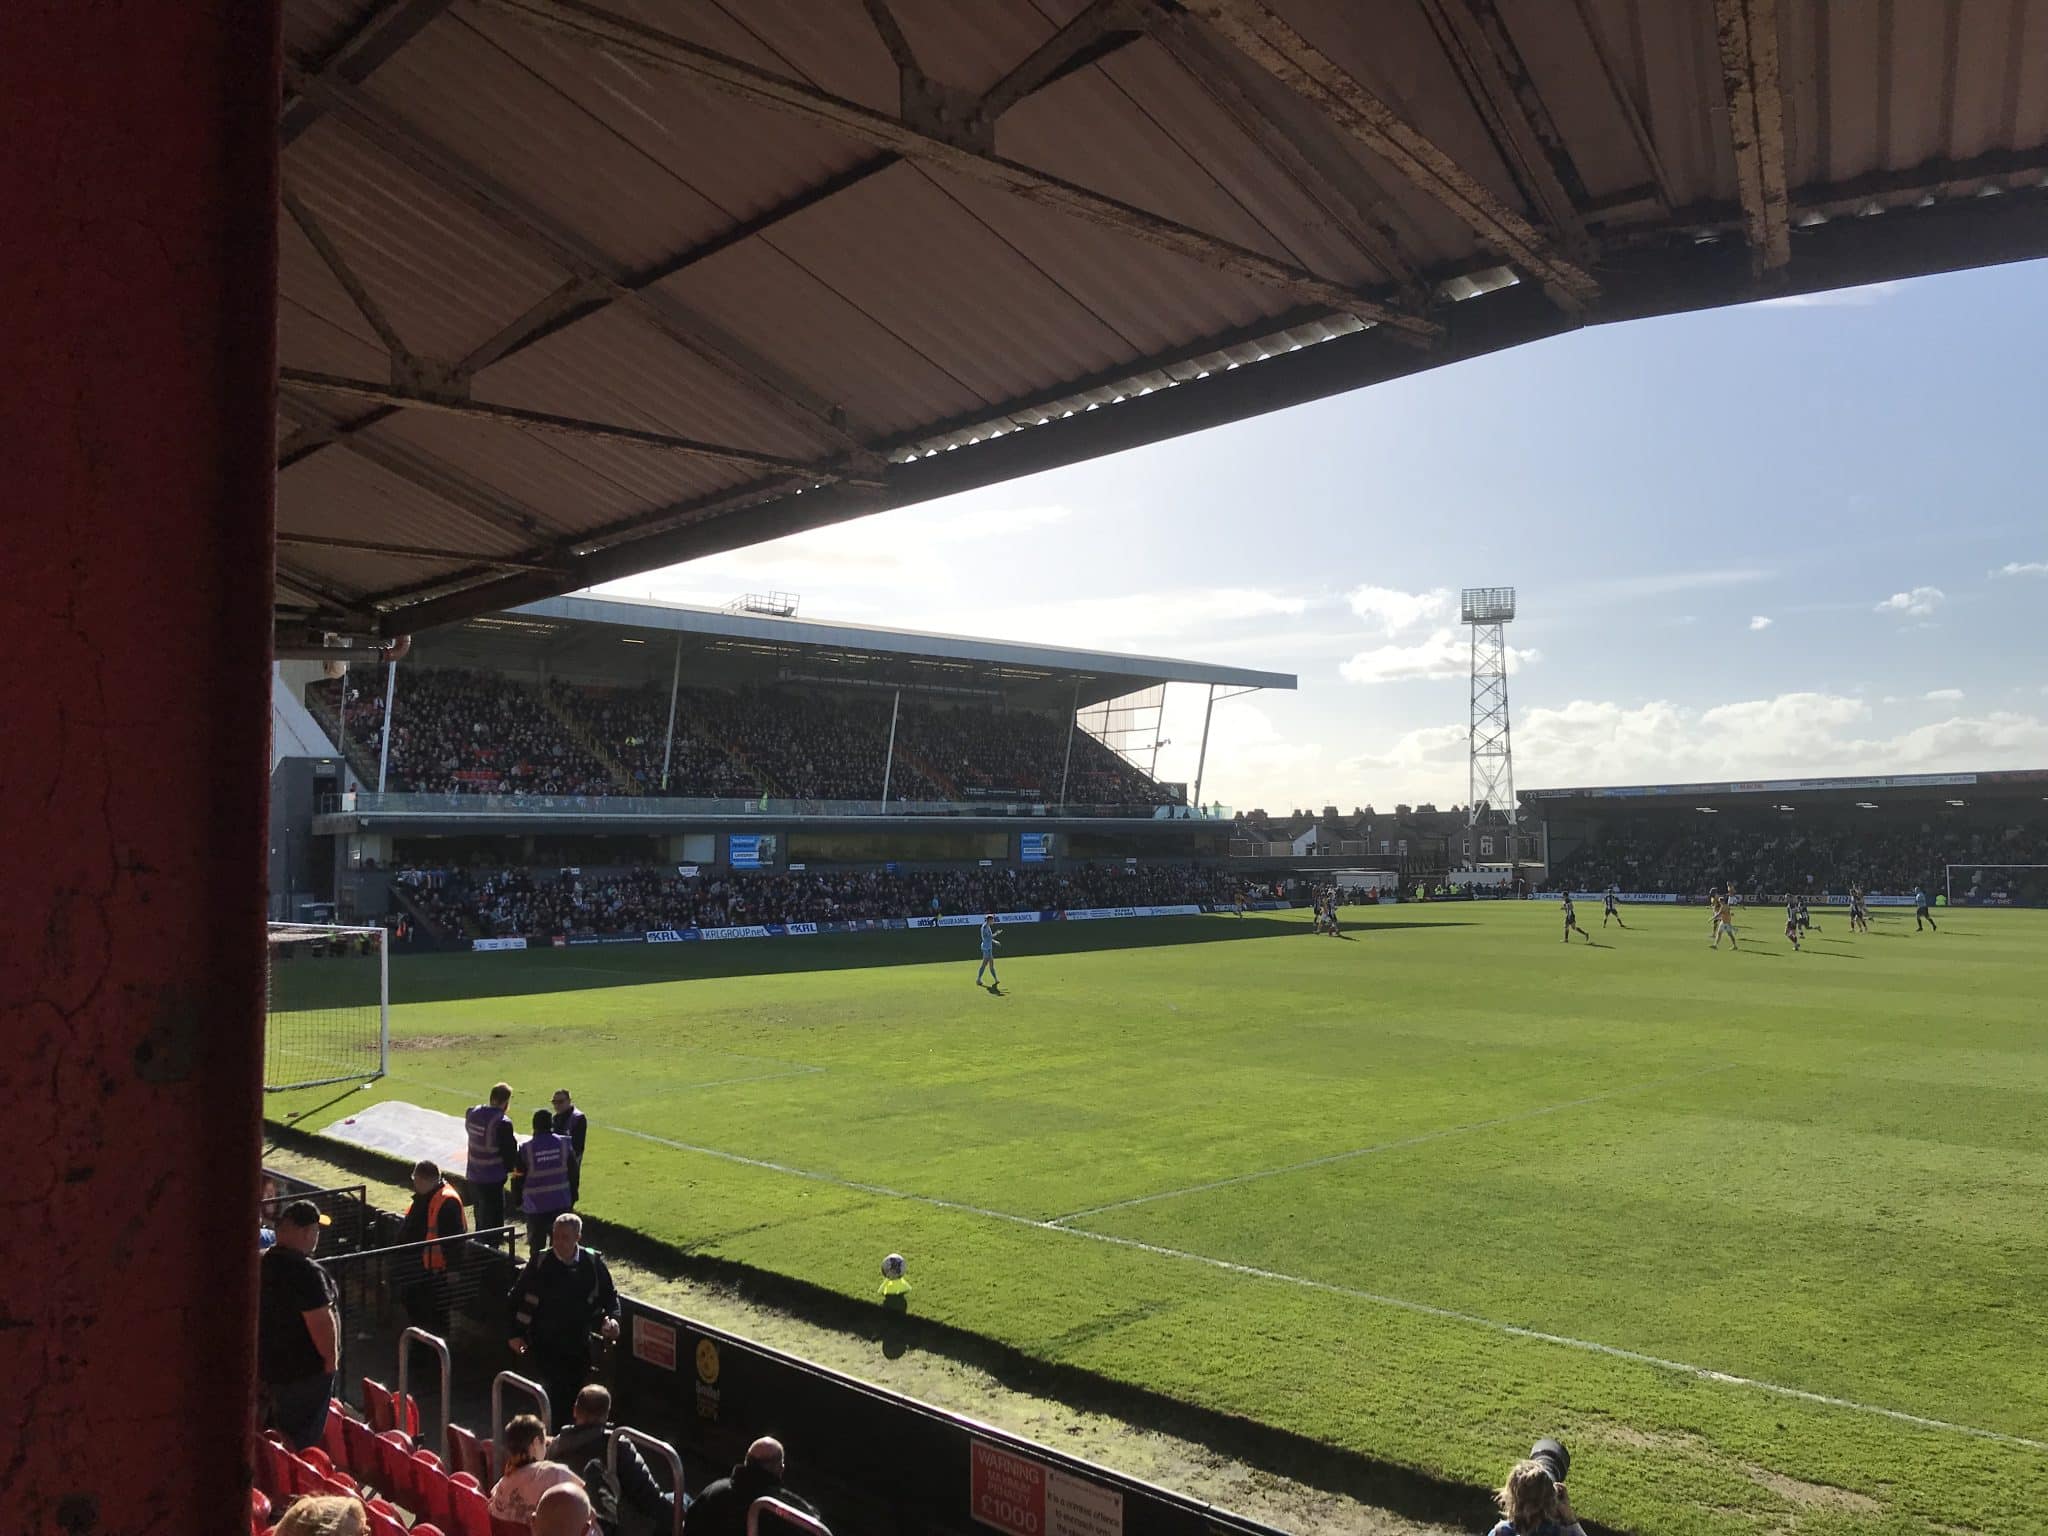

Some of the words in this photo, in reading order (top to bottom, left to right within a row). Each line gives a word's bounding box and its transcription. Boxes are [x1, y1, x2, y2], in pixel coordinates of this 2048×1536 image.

[654, 932, 678, 940] KRL
[977, 1448, 1039, 1483] WARNING
[981, 1494, 1038, 1533] £1000
